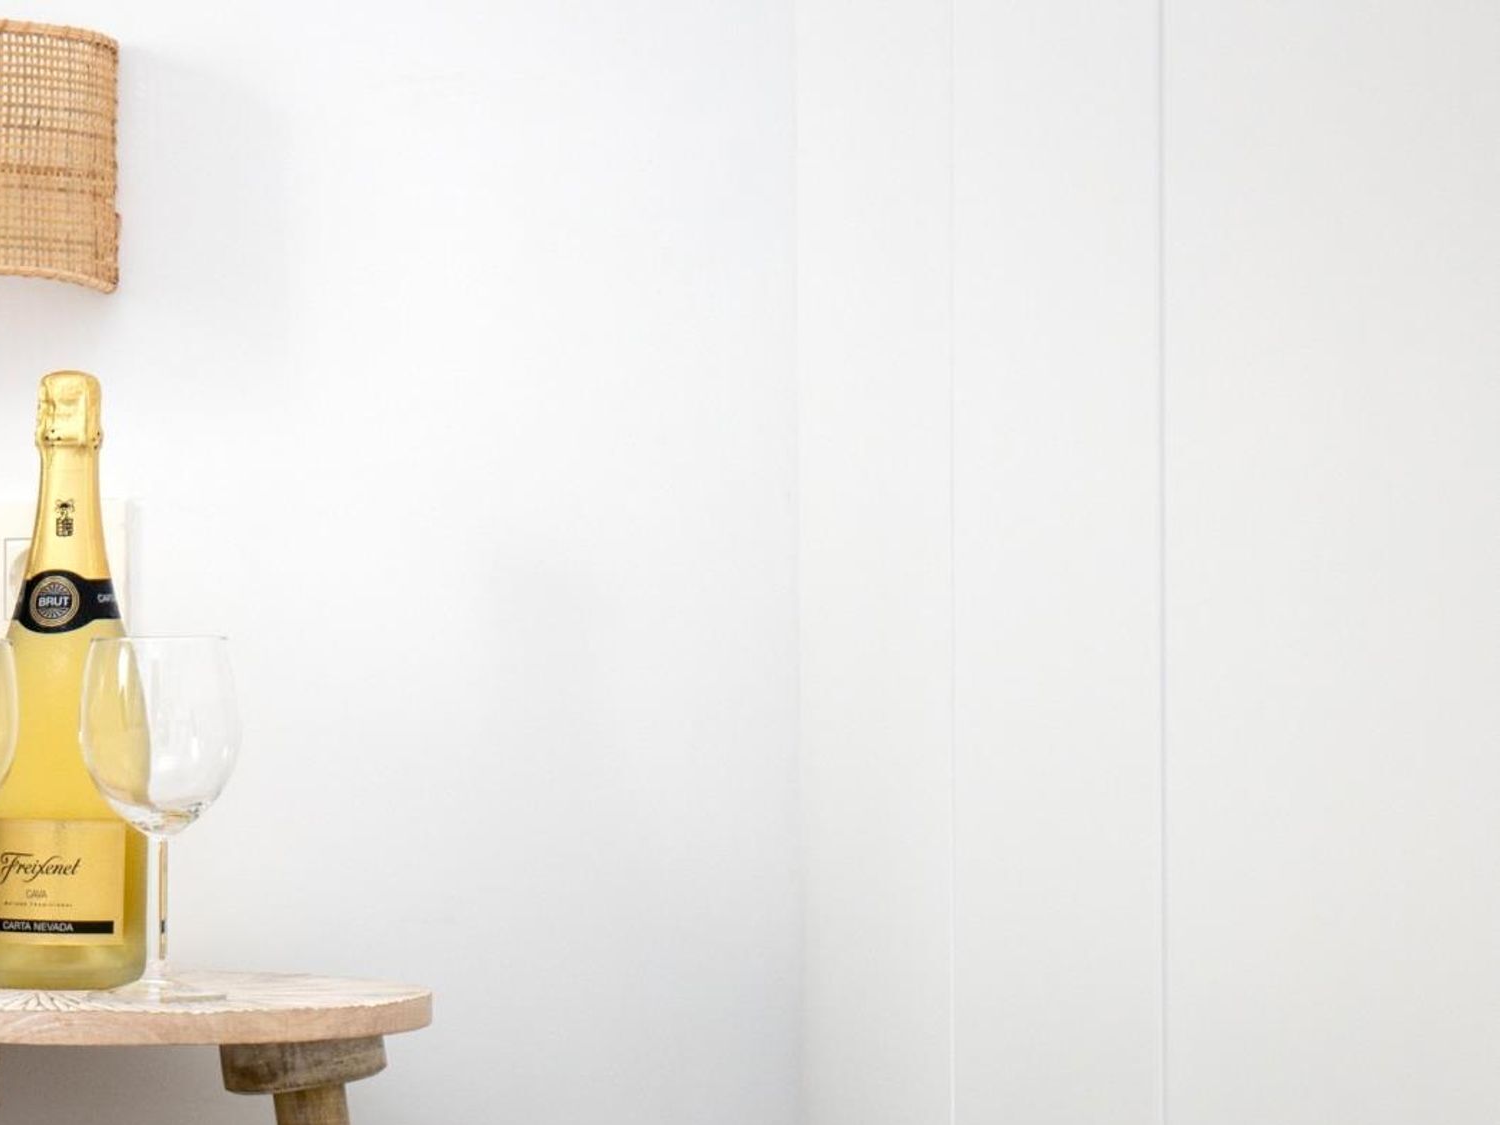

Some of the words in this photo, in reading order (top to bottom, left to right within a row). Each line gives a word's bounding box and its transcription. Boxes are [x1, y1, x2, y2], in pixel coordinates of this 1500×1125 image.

[38, 596, 70, 607] BRUT
[26, 889, 48, 899] CAVA
[2, 920, 32, 931] CARTA
[33, 922, 74, 933] NEVADA
